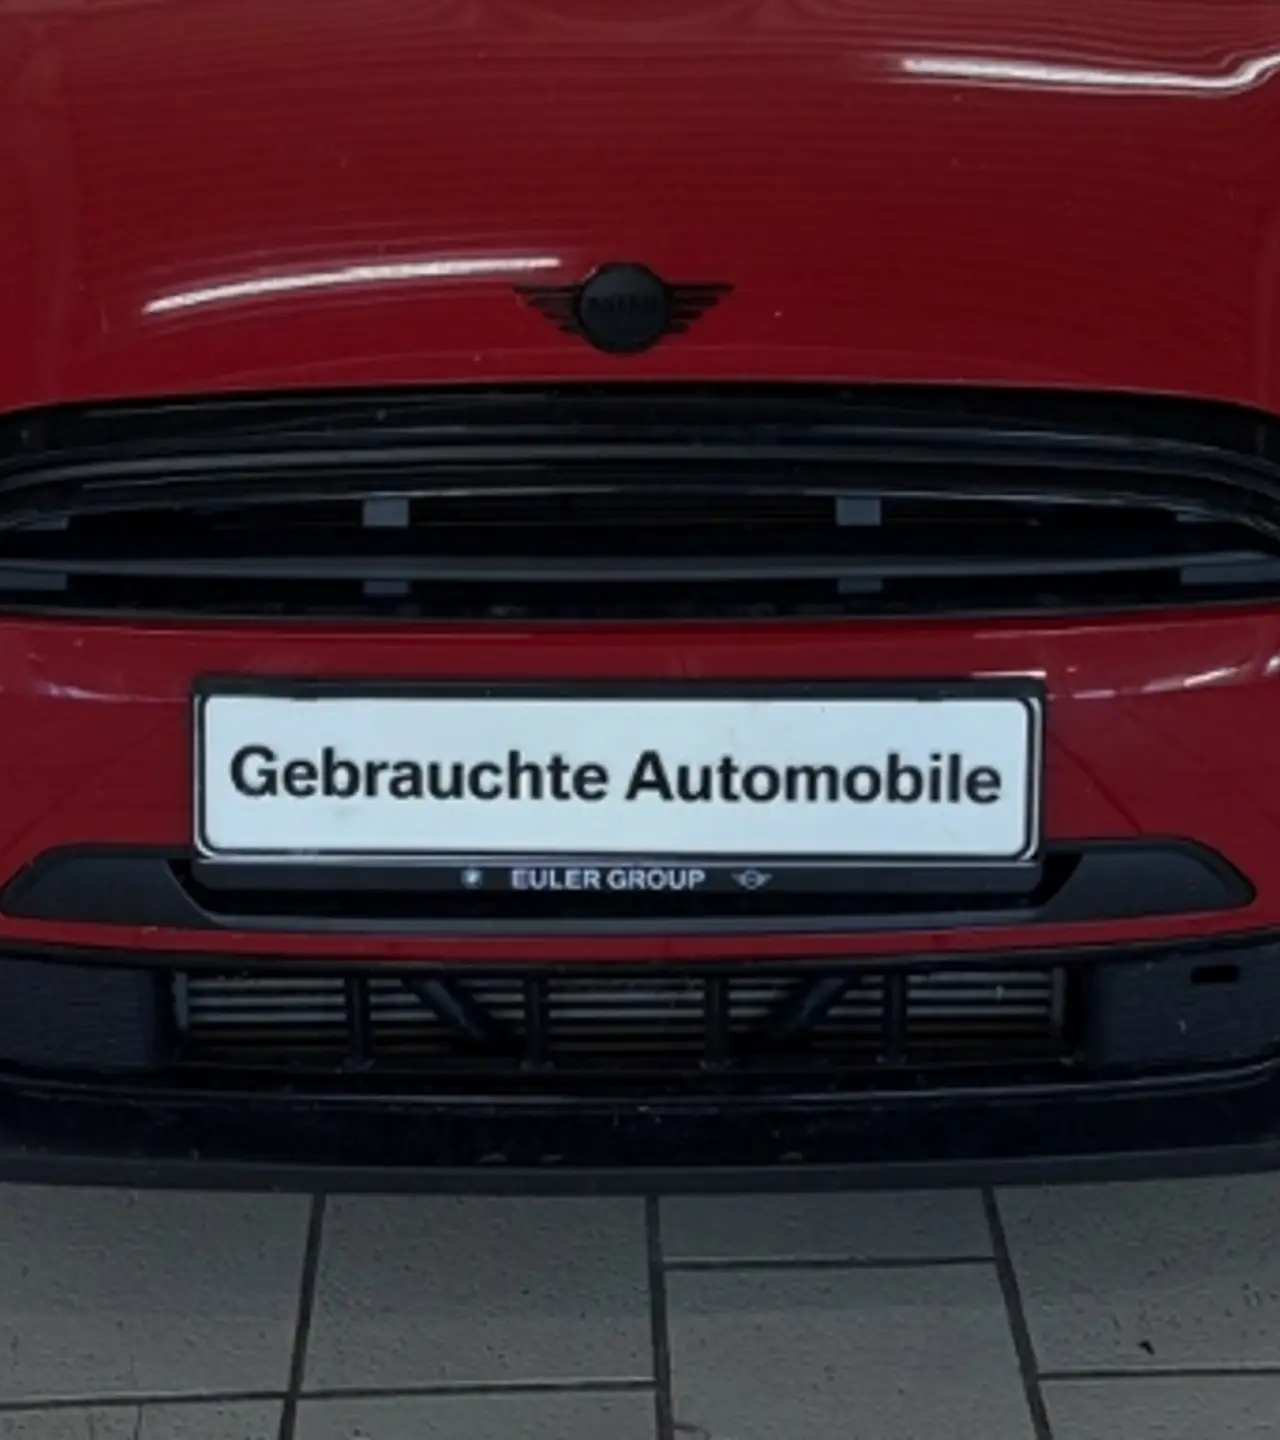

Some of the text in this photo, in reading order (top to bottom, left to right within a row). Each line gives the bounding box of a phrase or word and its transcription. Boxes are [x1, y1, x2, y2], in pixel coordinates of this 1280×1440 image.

[230, 745, 1001, 803] Gebrauchte Automobile
[511, 868, 705, 891] EULER GROUP
